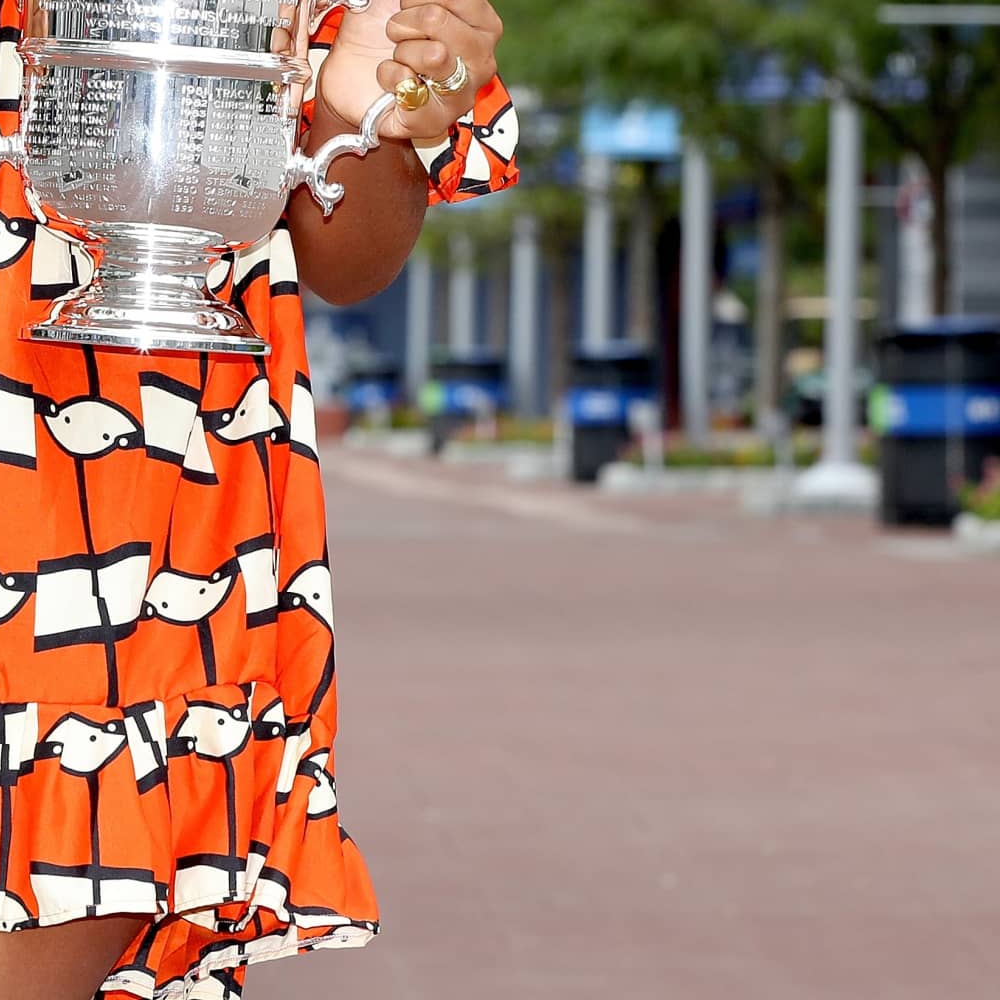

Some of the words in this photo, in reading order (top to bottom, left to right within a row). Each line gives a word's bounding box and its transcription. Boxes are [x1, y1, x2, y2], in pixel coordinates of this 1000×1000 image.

[169, 23, 240, 39] SINGLES
[87, 79, 125, 91] COURT
[87, 91, 122, 102] COURT
[215, 87, 253, 100] TRACY
[81, 102, 108, 113] KING
[80, 115, 107, 126] KING
[85, 127, 120, 137] COURT
